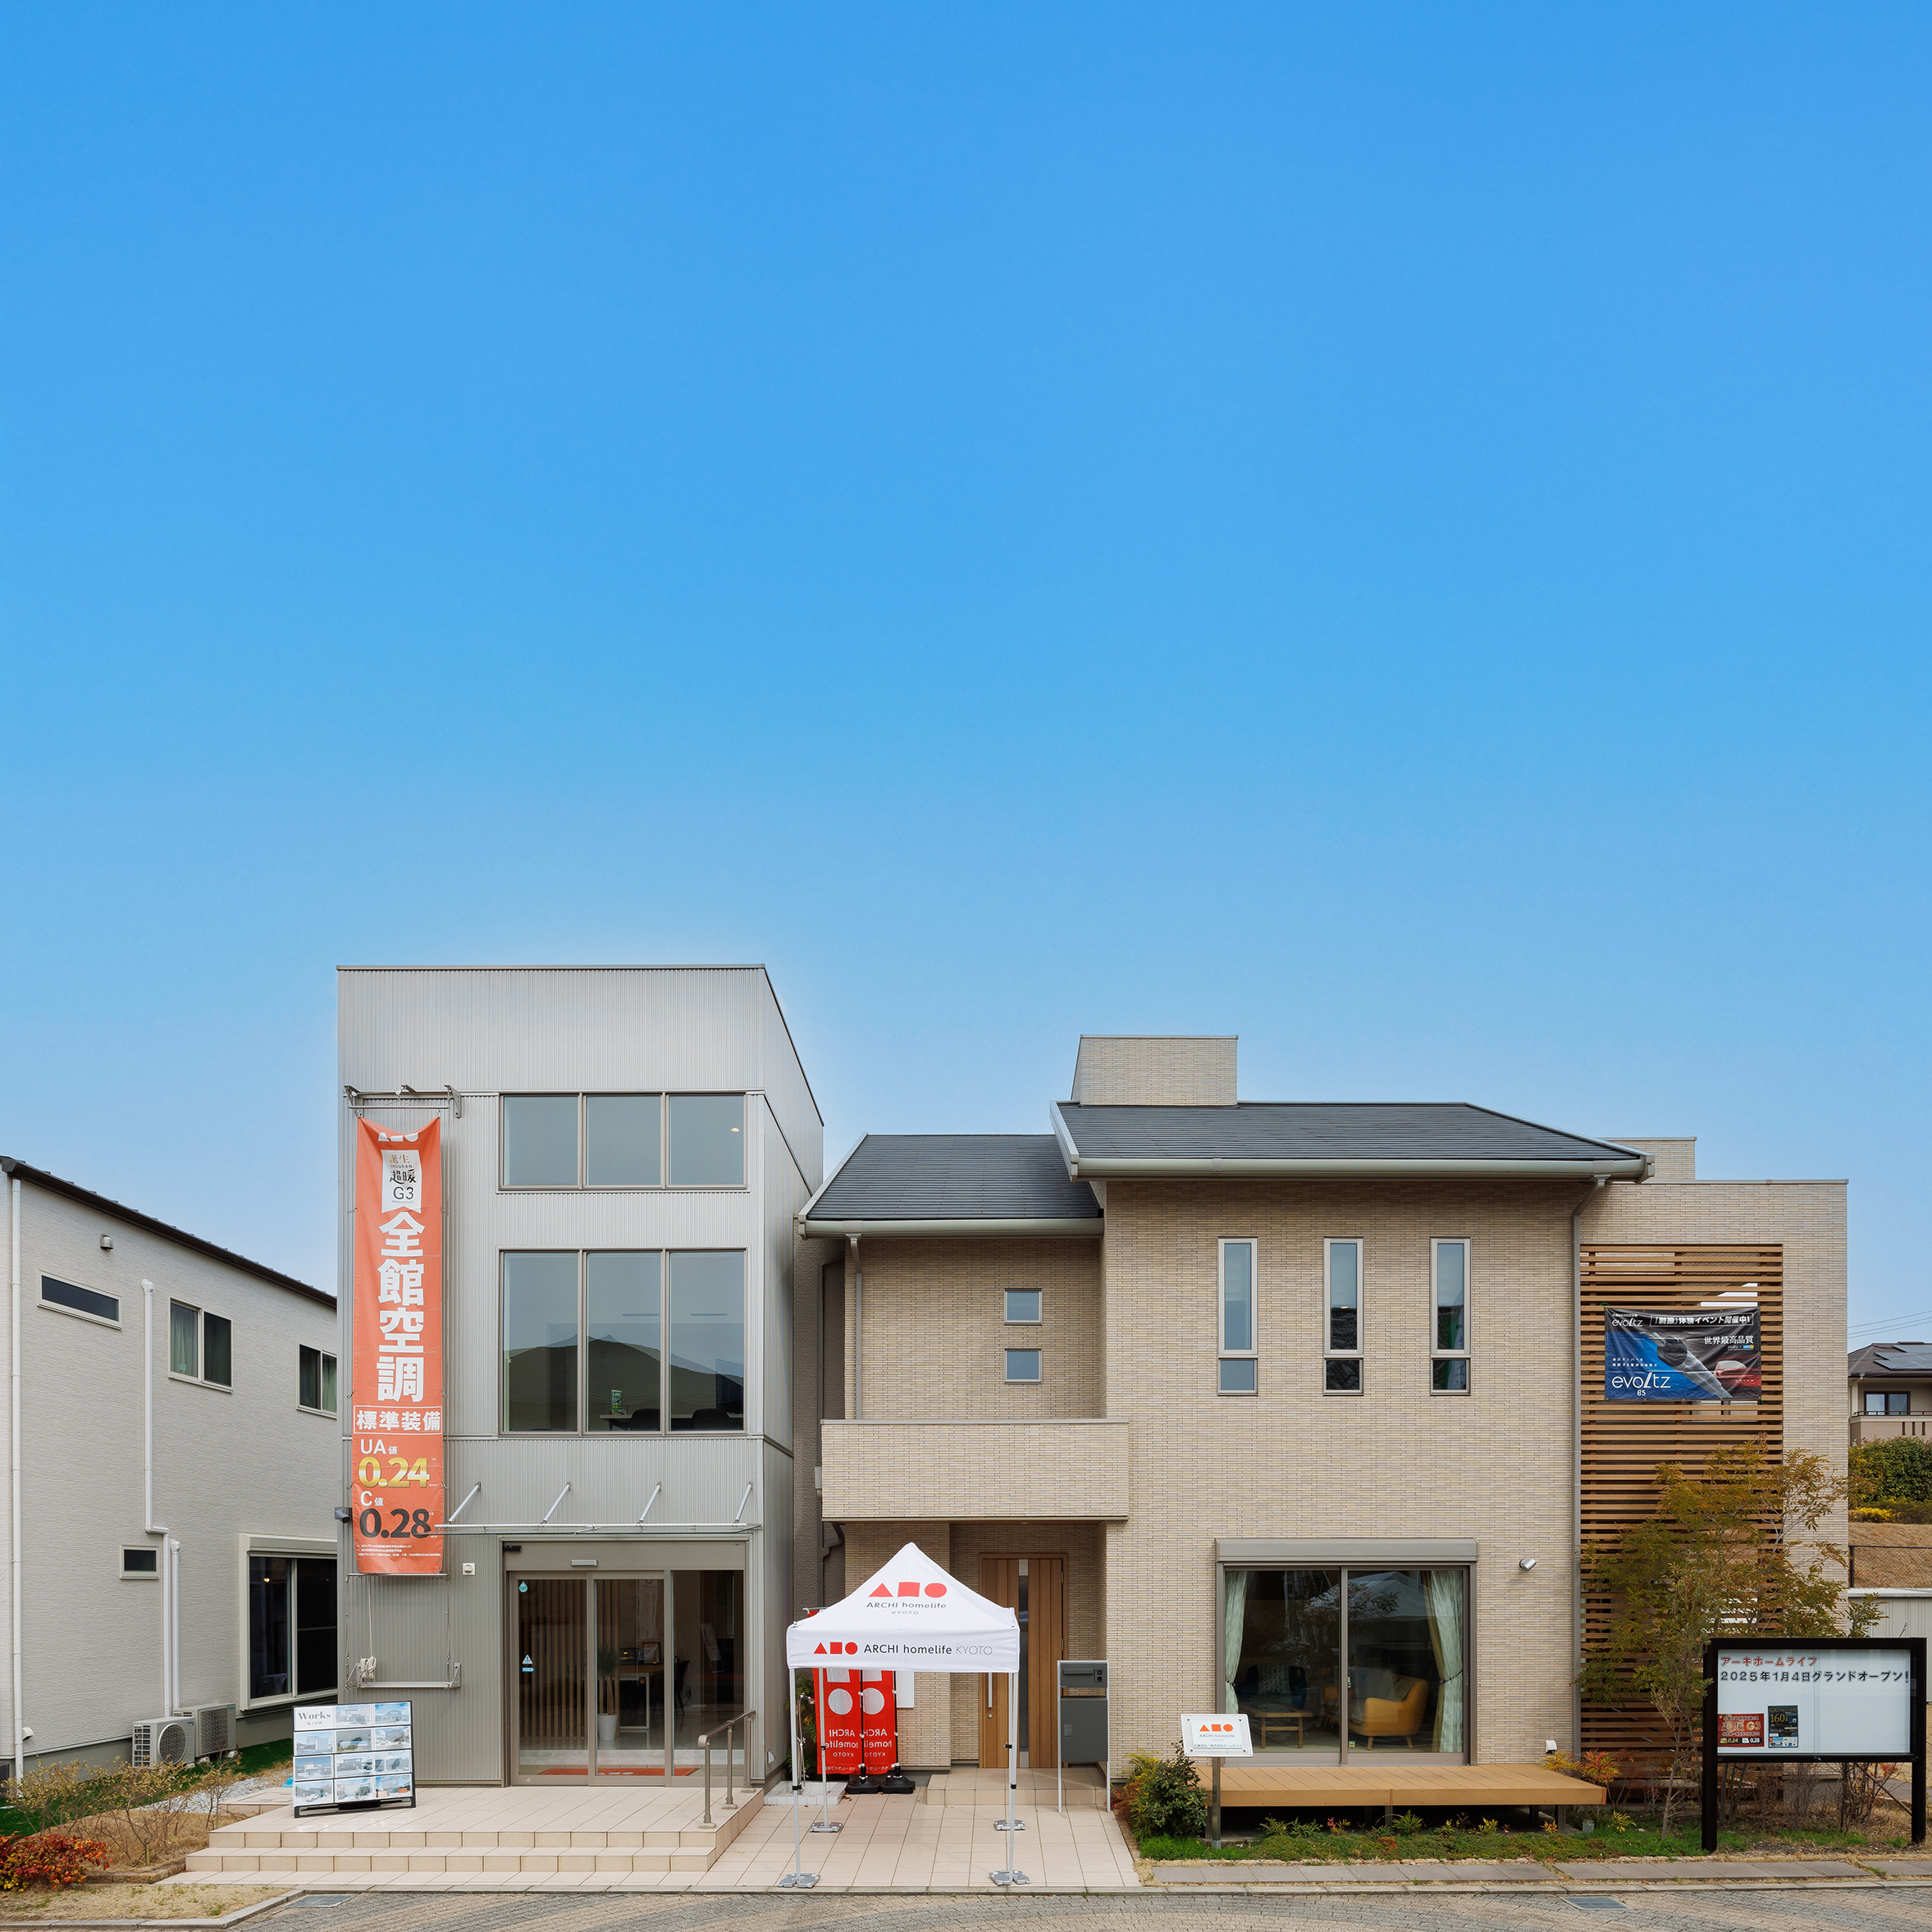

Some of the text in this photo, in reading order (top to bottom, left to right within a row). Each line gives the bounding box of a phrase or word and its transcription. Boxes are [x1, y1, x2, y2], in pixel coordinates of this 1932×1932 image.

[390, 1169, 417, 1185] 超暖
[393, 1186, 414, 1200] G3
[376, 1211, 426, 1403] 全館空調
[1704, 1335, 1754, 1345] 世界最高品質
[356, 1409, 441, 1432] 標準装備
[359, 1456, 431, 1489] 0.24
[359, 1508, 432, 1539] 0.28
[863, 1643, 993, 1656] ARCHI homelife KYOTO
[1720, 1656, 1818, 1667] アーキホームライフ
[298, 1710, 331, 1720] Works
[1770, 1713, 1786, 1723] 160
[1746, 1721, 1761, 1731] G3
